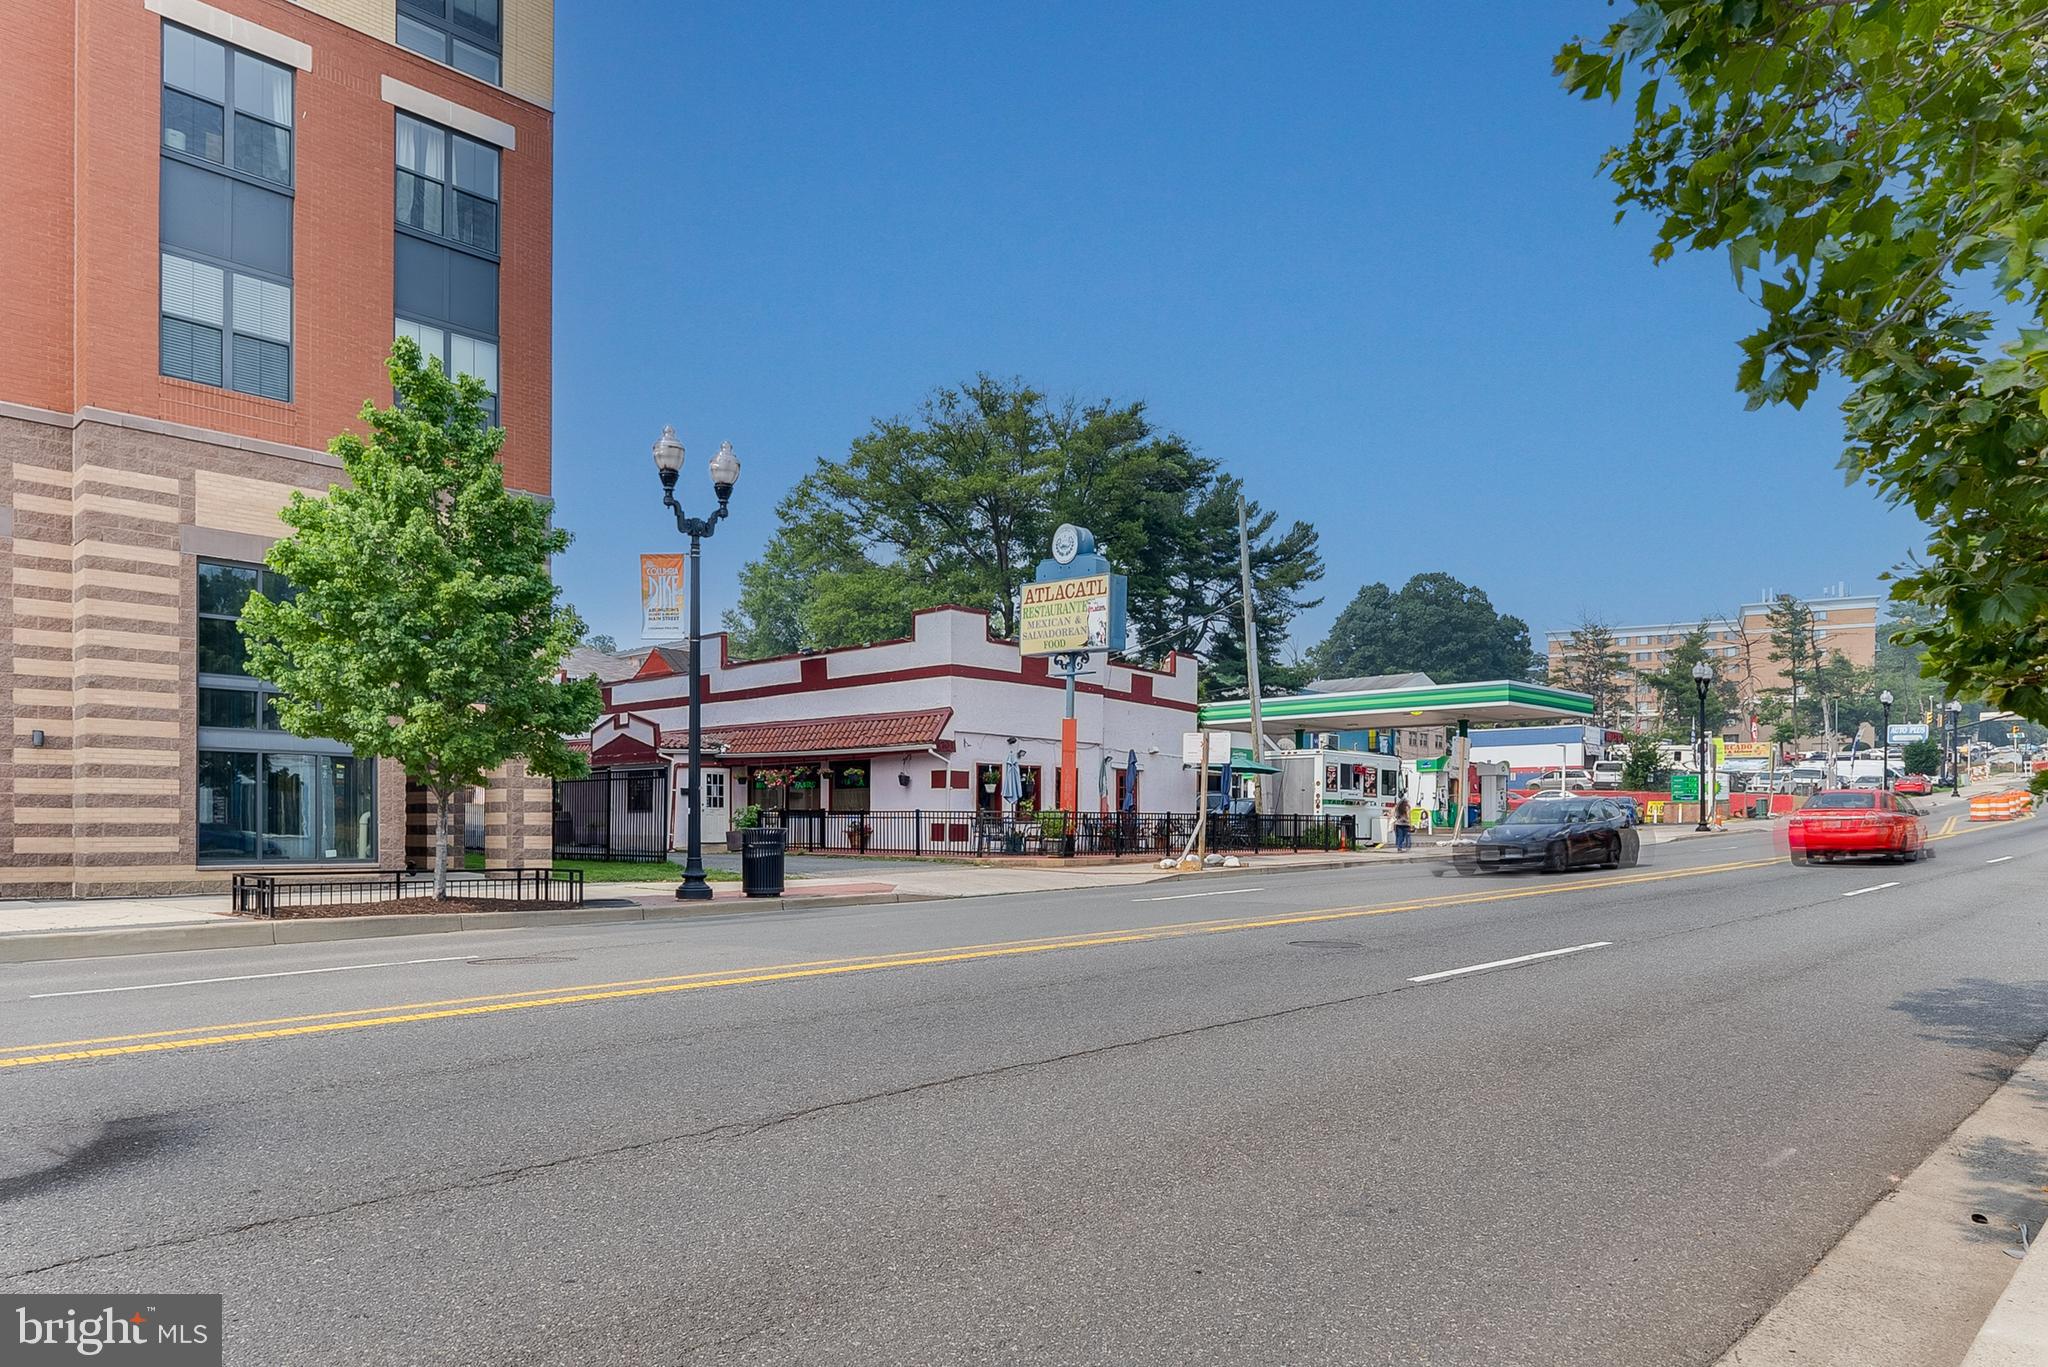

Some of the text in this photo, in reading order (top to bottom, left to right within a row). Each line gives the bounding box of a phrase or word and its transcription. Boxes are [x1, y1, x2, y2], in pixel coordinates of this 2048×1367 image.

[1024, 579, 1107, 605] ATLACATL
[1022, 599, 1088, 620] RESTAURANTE
[1027, 615, 1082, 629] MEXICAN &
[1022, 626, 1088, 641] SALVADOREAN
[1043, 639, 1066, 649] FOOD
